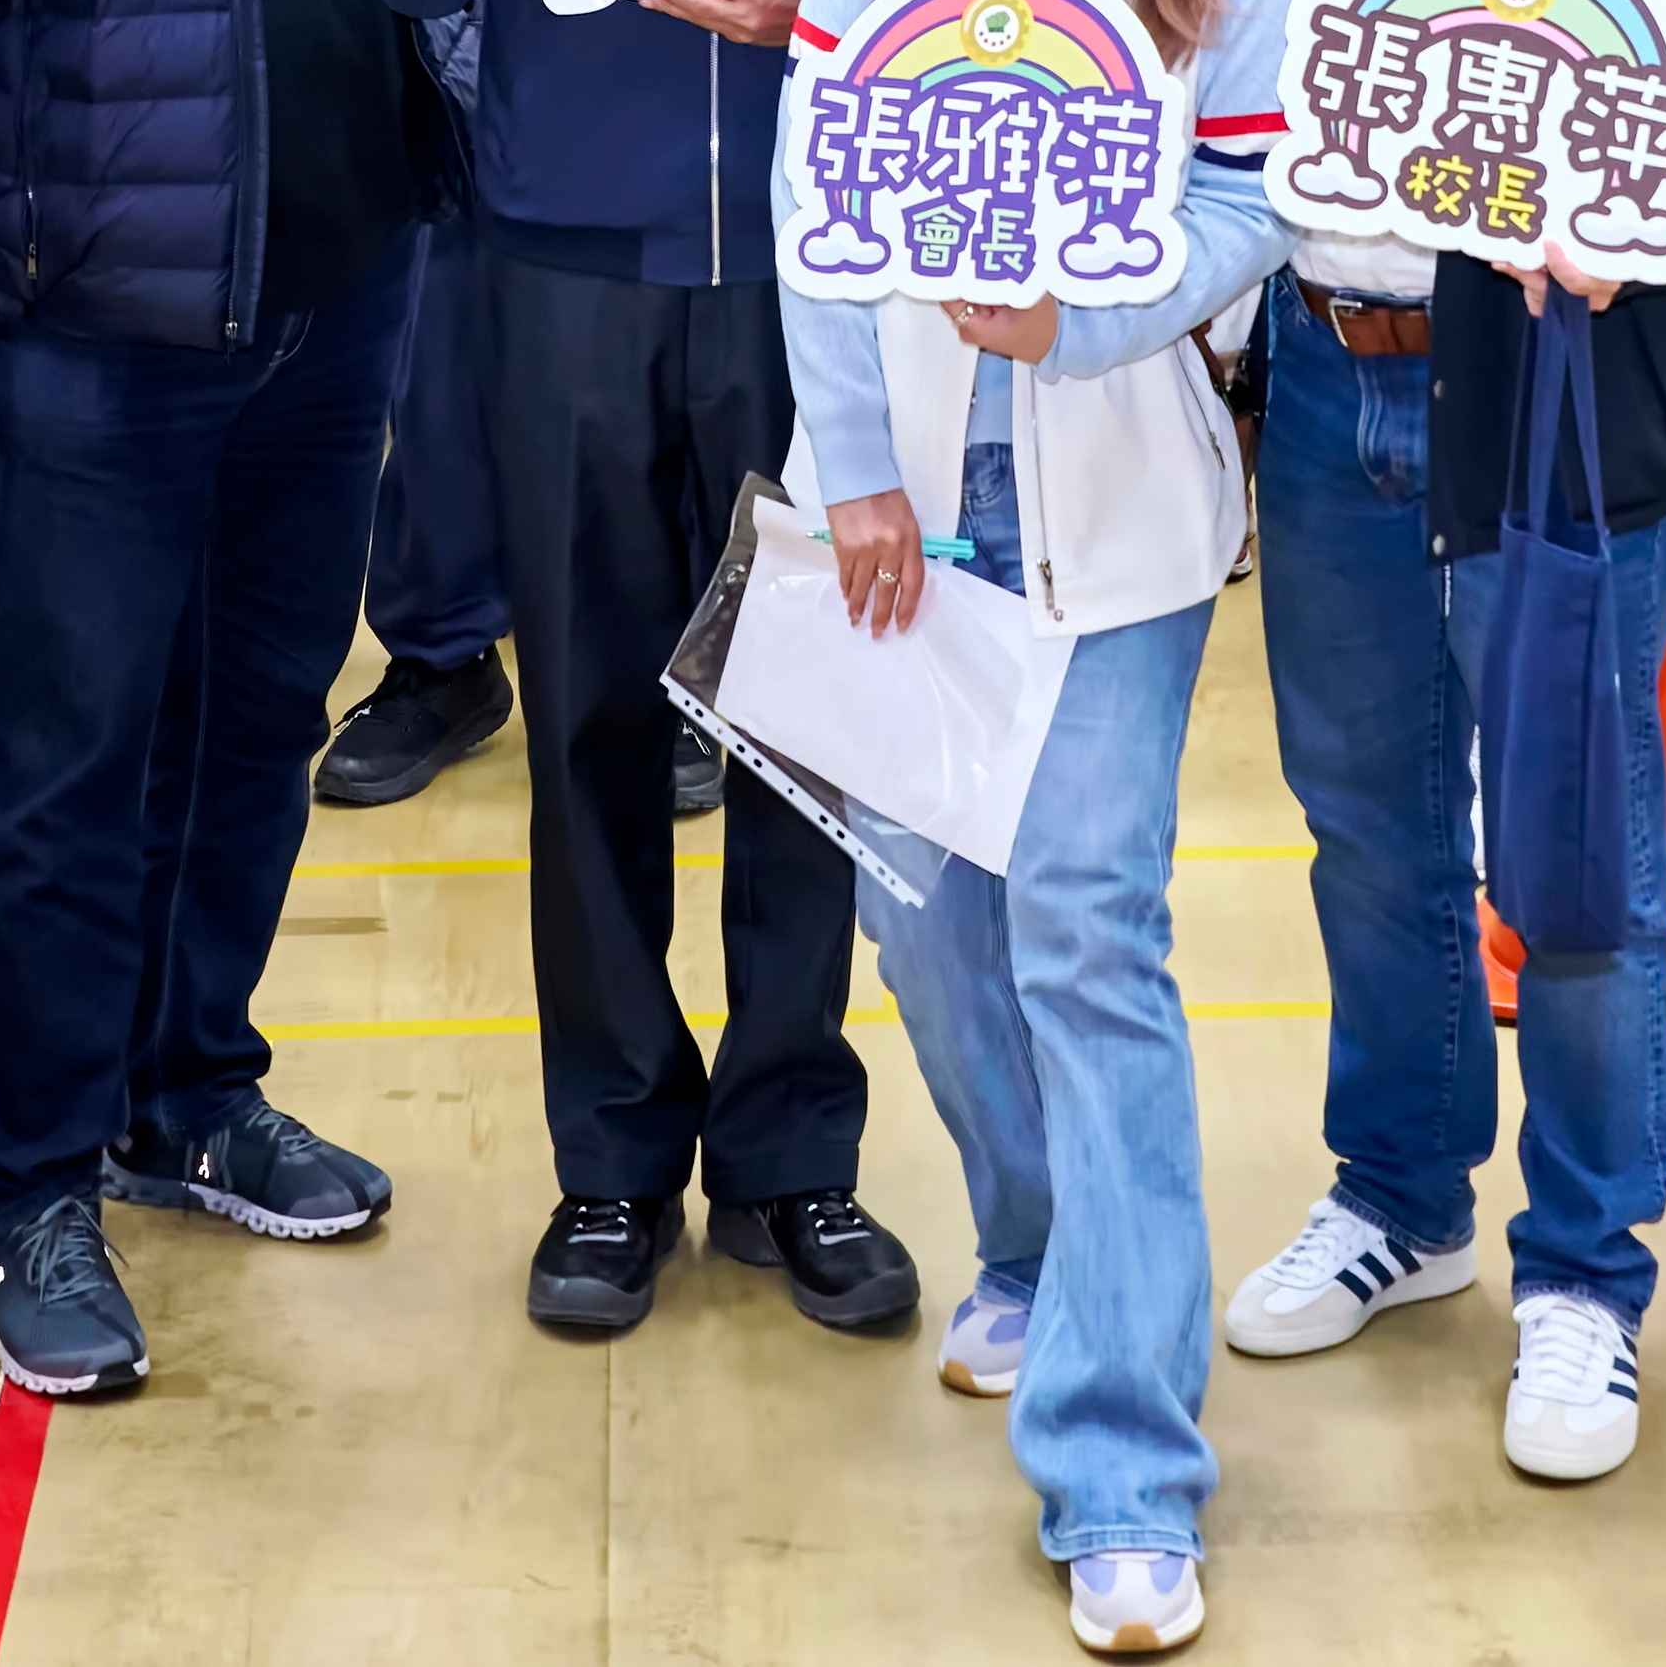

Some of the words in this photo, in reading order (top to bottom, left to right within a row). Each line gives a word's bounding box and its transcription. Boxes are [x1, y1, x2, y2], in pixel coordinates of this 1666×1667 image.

[816, 85, 1153, 206] 張雅萍
[1406, 155, 1537, 233] 校長
[911, 203, 1027, 273] 會長
